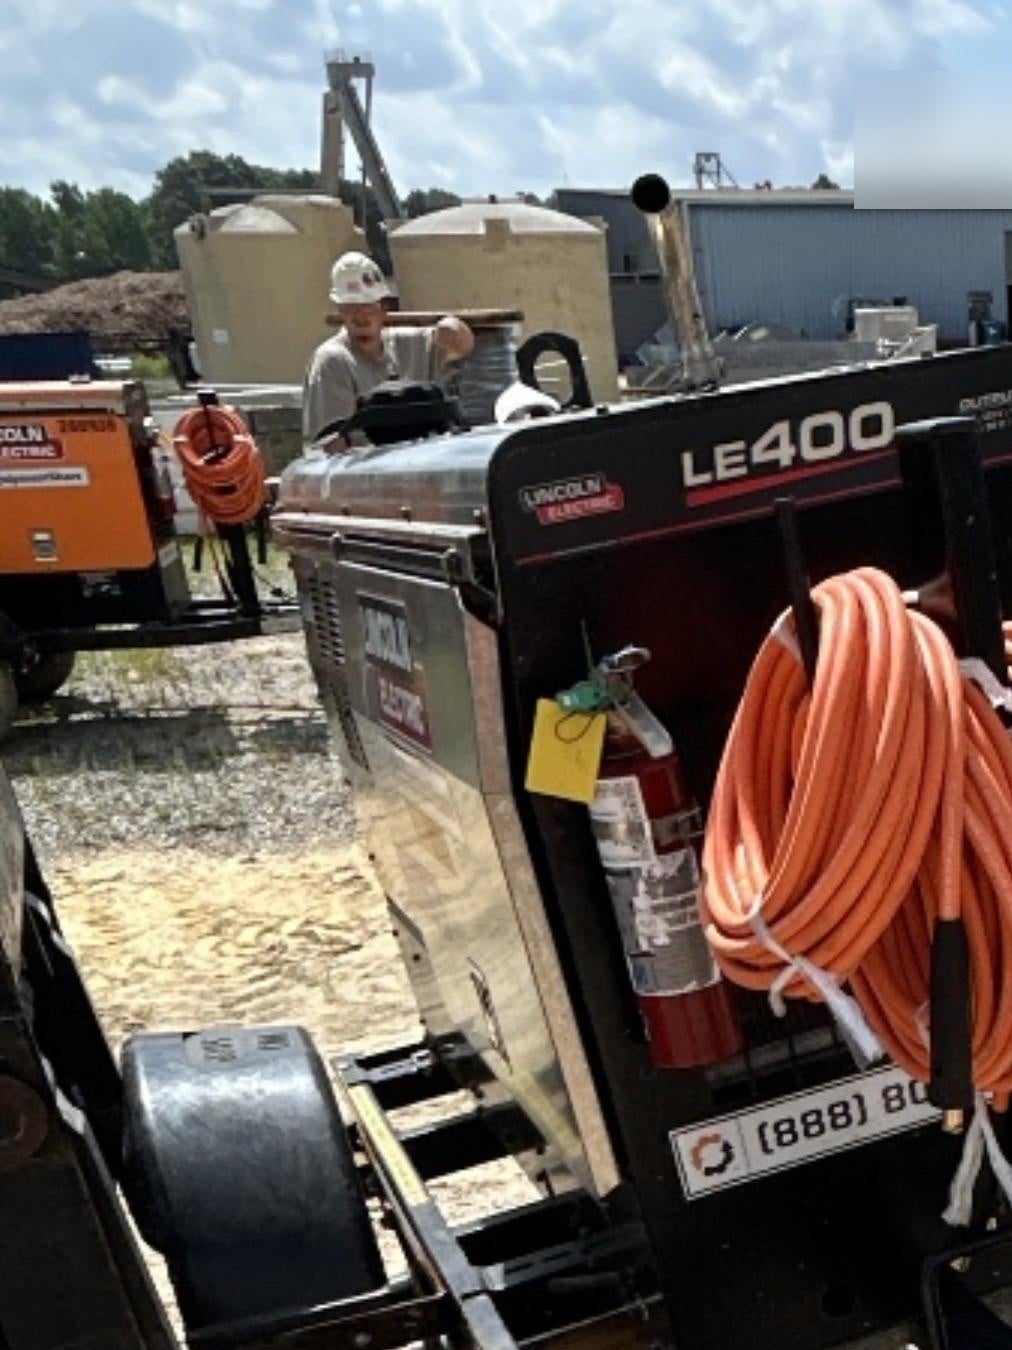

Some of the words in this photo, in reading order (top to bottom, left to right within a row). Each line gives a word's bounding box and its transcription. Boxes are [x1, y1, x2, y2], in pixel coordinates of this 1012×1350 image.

[681, 401, 895, 487] LE400
[523, 478, 601, 507] LINCOLN
[757, 1093, 868, 1154] (888)
